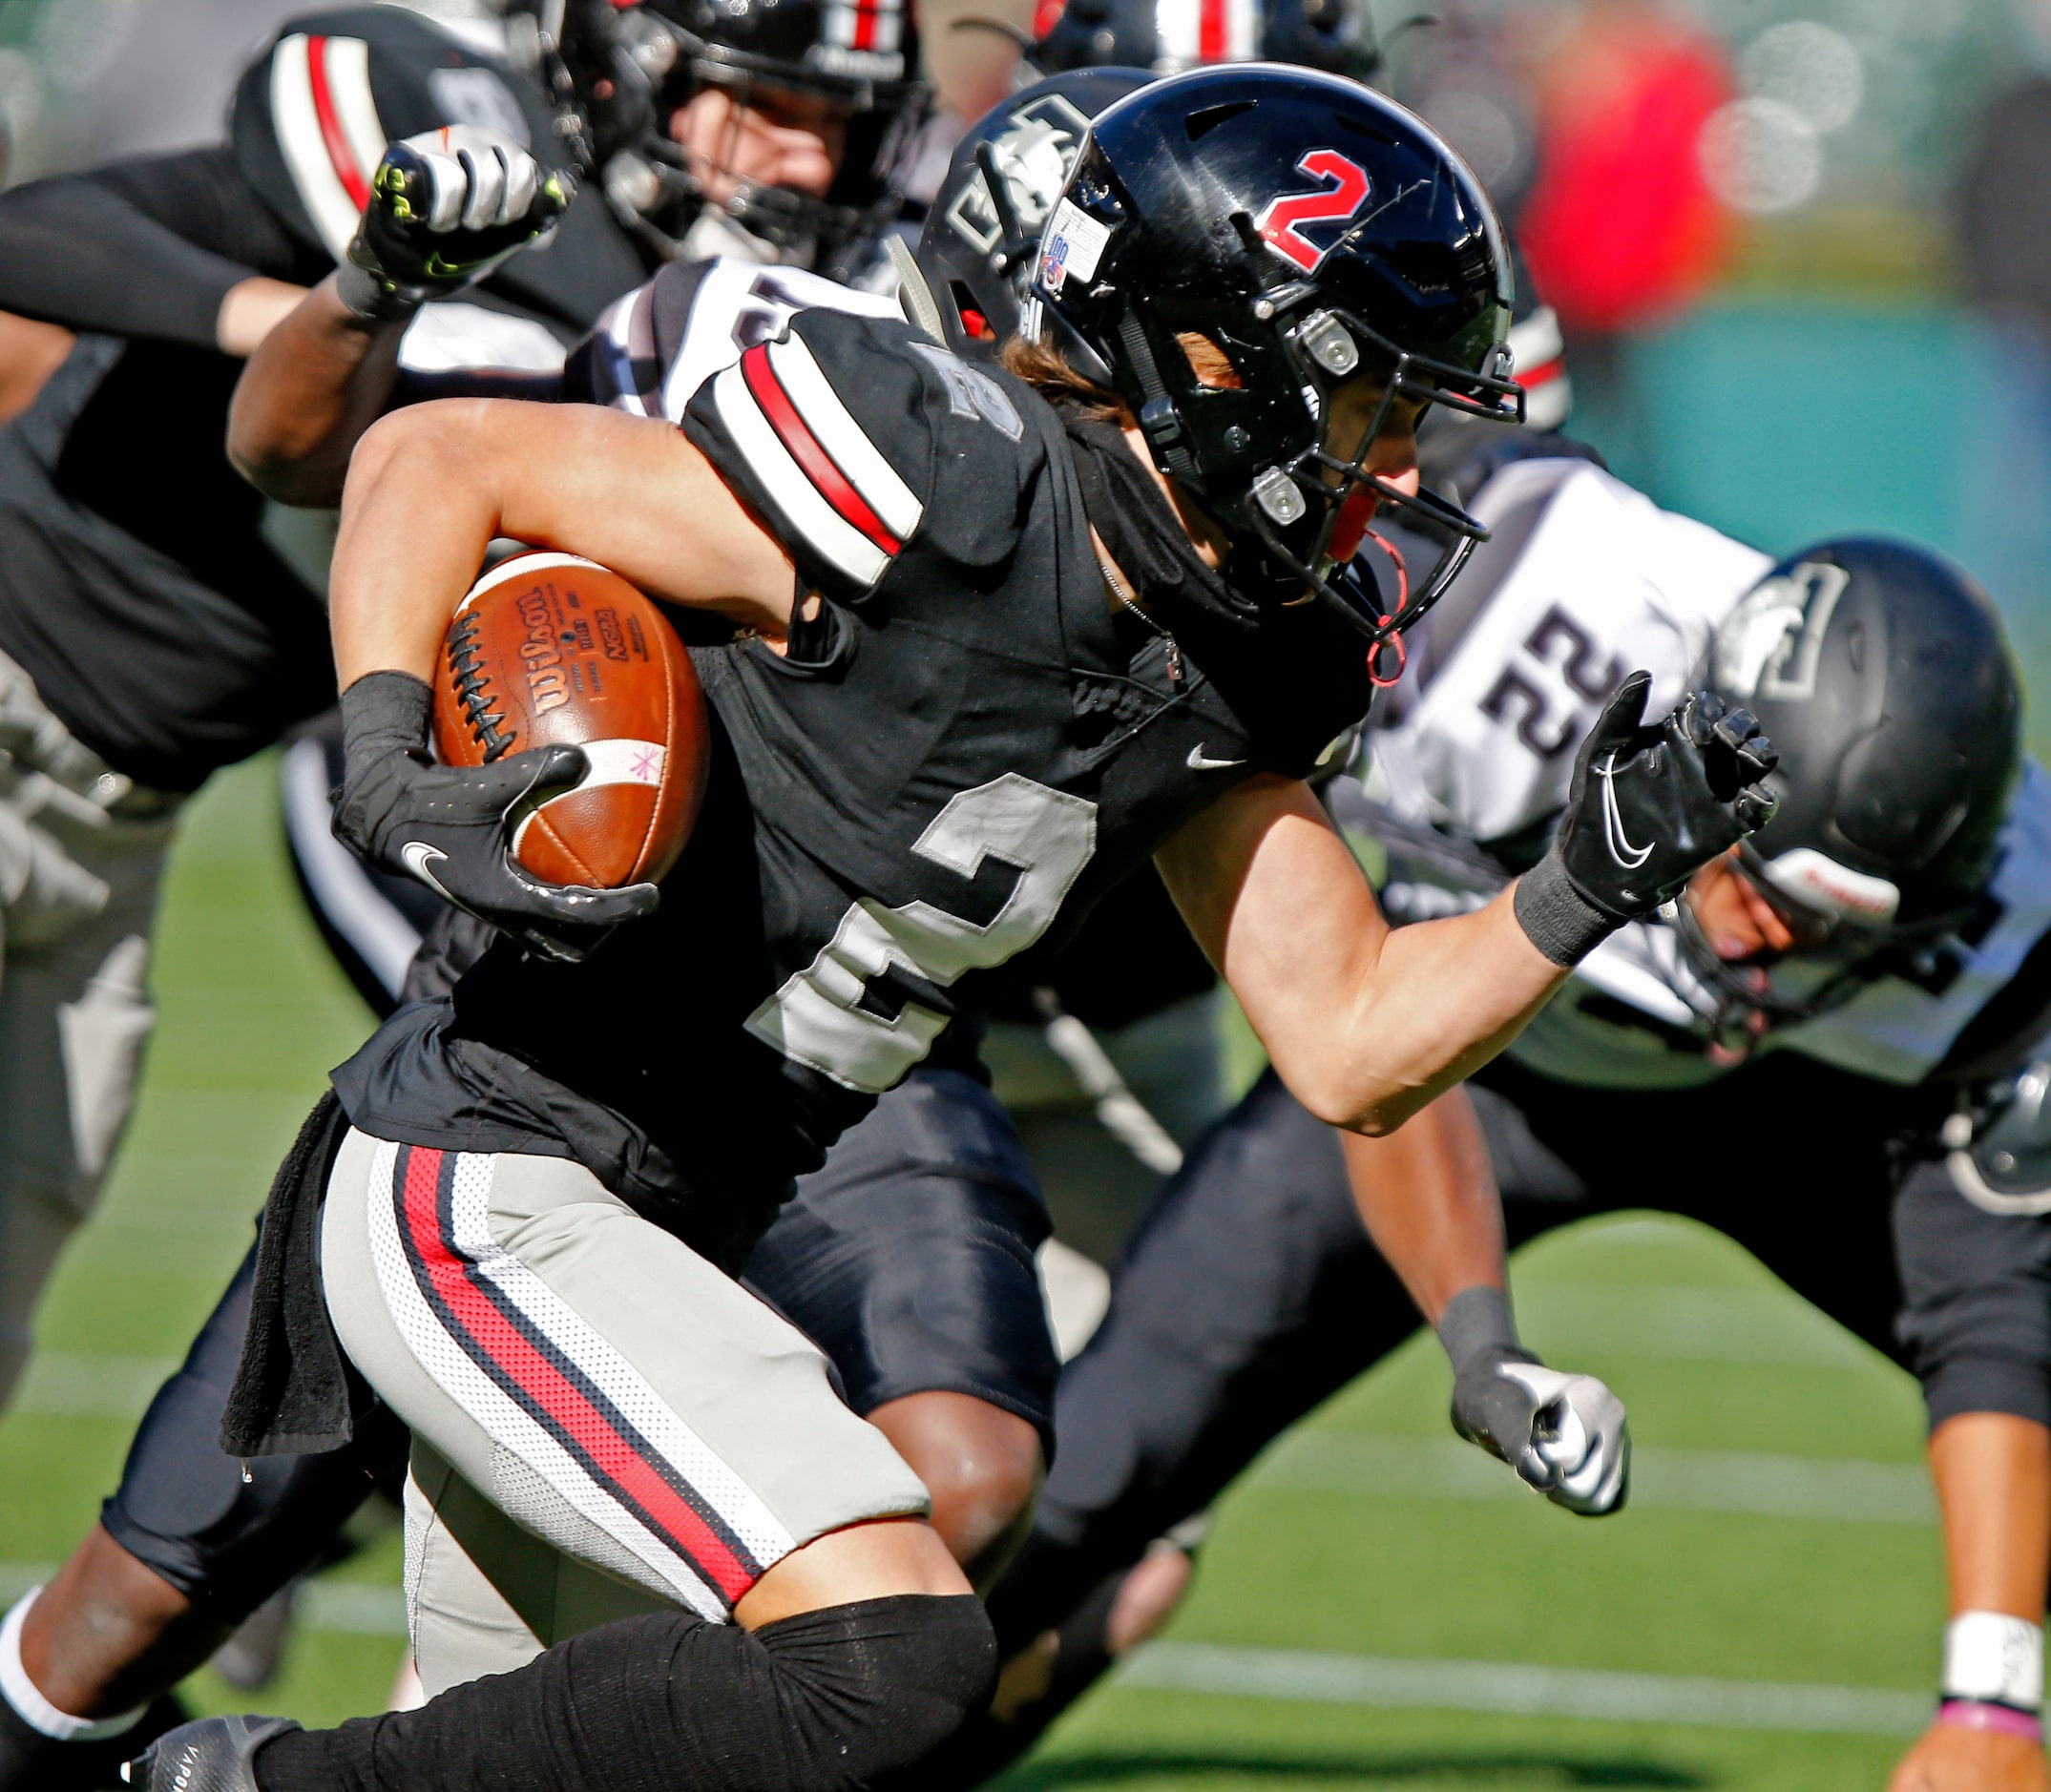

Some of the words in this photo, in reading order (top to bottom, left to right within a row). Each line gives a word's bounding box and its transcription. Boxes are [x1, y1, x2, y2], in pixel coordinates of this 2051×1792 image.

[1252, 149, 1371, 276] 2
[515, 586, 571, 718] Wilson
[595, 607, 629, 662] NCAA
[1476, 599, 1626, 761] 22
[743, 771, 1099, 1094] 2
